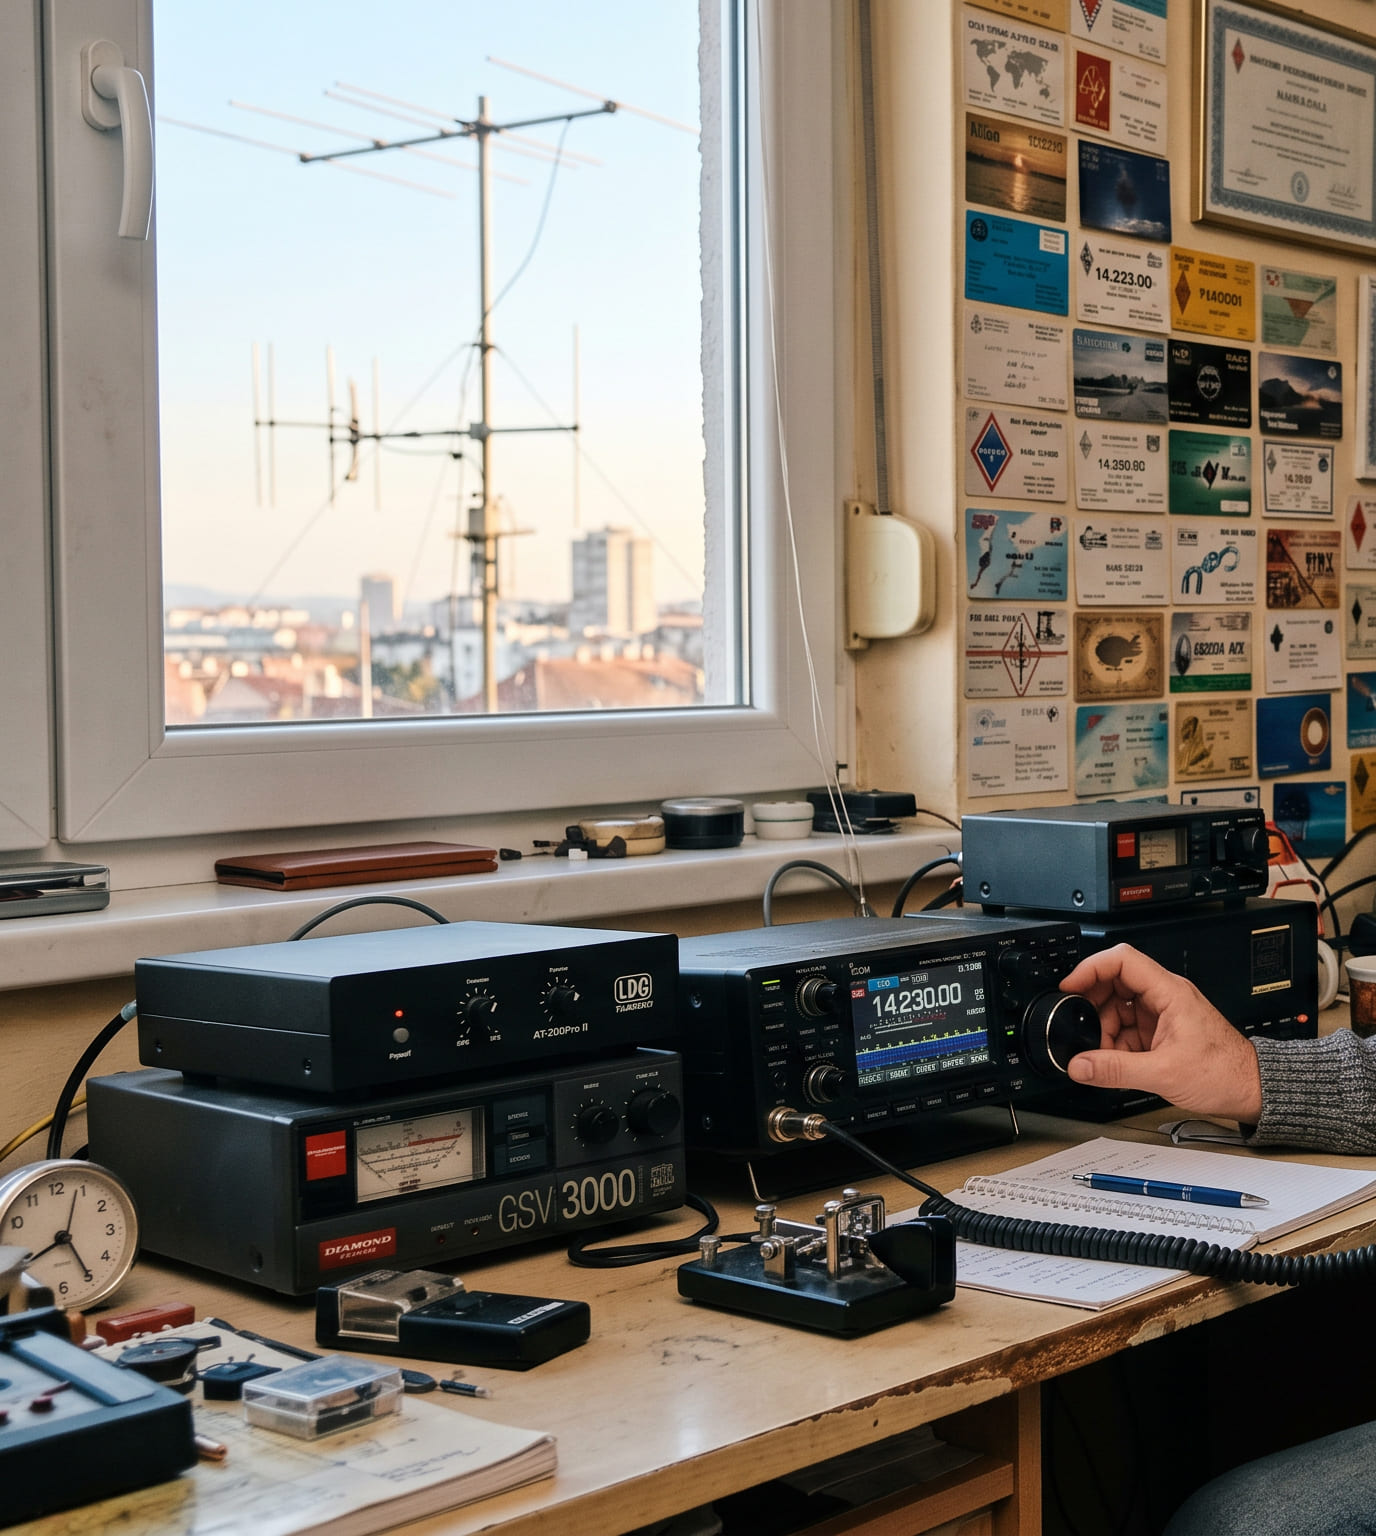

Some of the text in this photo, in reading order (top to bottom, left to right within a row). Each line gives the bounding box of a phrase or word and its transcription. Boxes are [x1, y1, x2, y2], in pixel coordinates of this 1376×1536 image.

[1096, 267, 1153, 289] 14.223.00
[619, 977, 649, 1000] LDG
[872, 982, 962, 1017] 14.230.00
[533, 1026, 581, 1040] AT-200Pro
[48, 1182, 65, 1196] 12
[79, 1184, 86, 1197] 1
[25, 1193, 39, 1208] 11
[97, 1199, 107, 1213] 2
[498, 1168, 636, 1233] GSV 3000
[105, 1223, 115, 1236] 3
[324, 1235, 392, 1257] DIAMOND
[101, 1249, 111, 1262] 4
[83, 1269, 93, 1283] 5
[58, 1281, 69, 1295] 6
